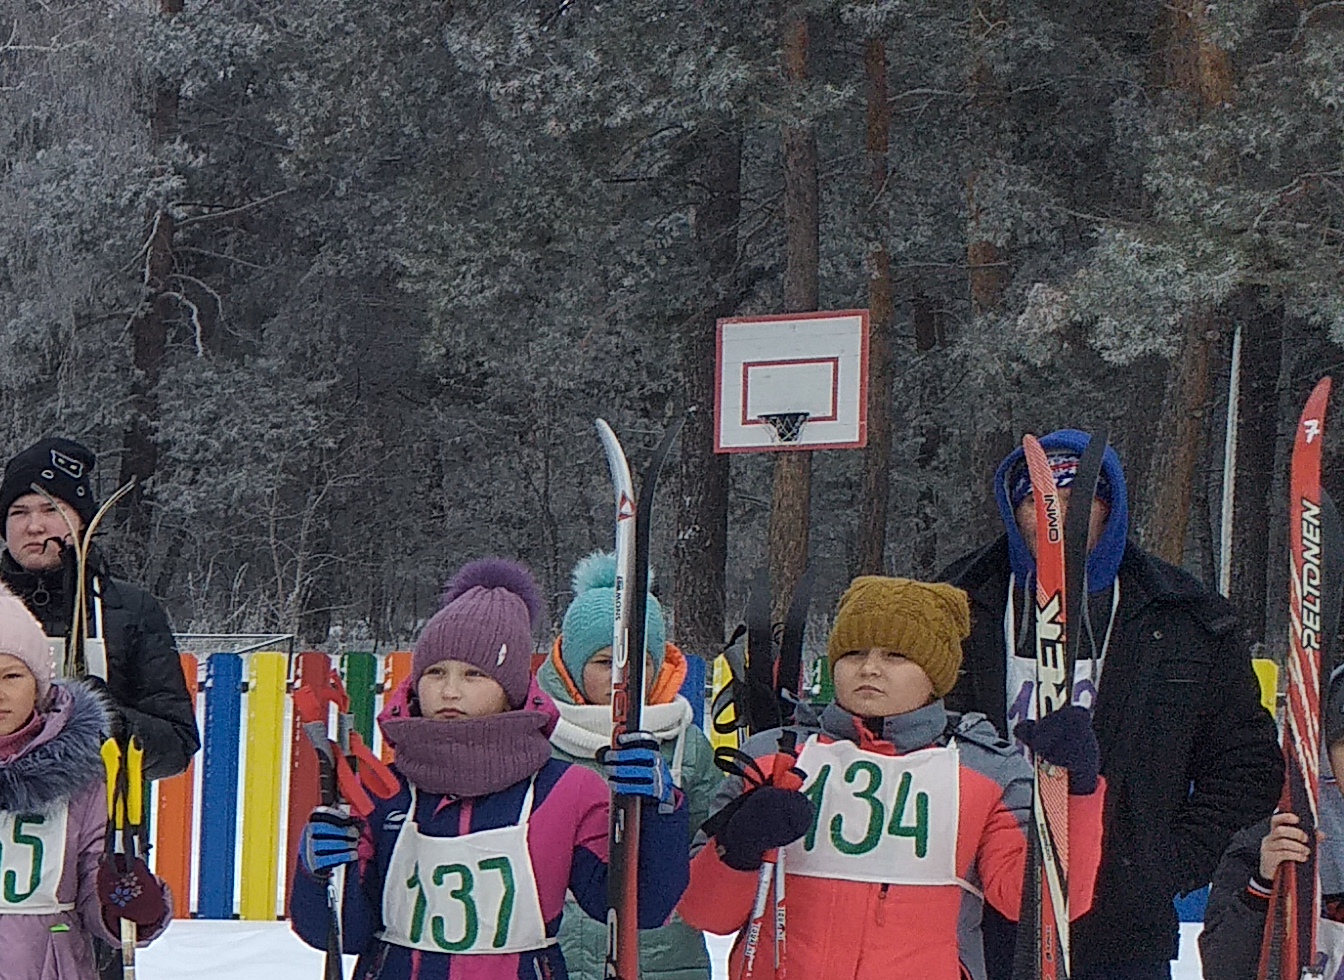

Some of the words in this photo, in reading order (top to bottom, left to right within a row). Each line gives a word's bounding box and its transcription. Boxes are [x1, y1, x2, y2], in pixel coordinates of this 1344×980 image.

[1043, 493, 1059, 543] OMNI
[1301, 500, 1321, 650] PELTONEN
[803, 759, 929, 860] 134
[406, 856, 516, 952] 137
